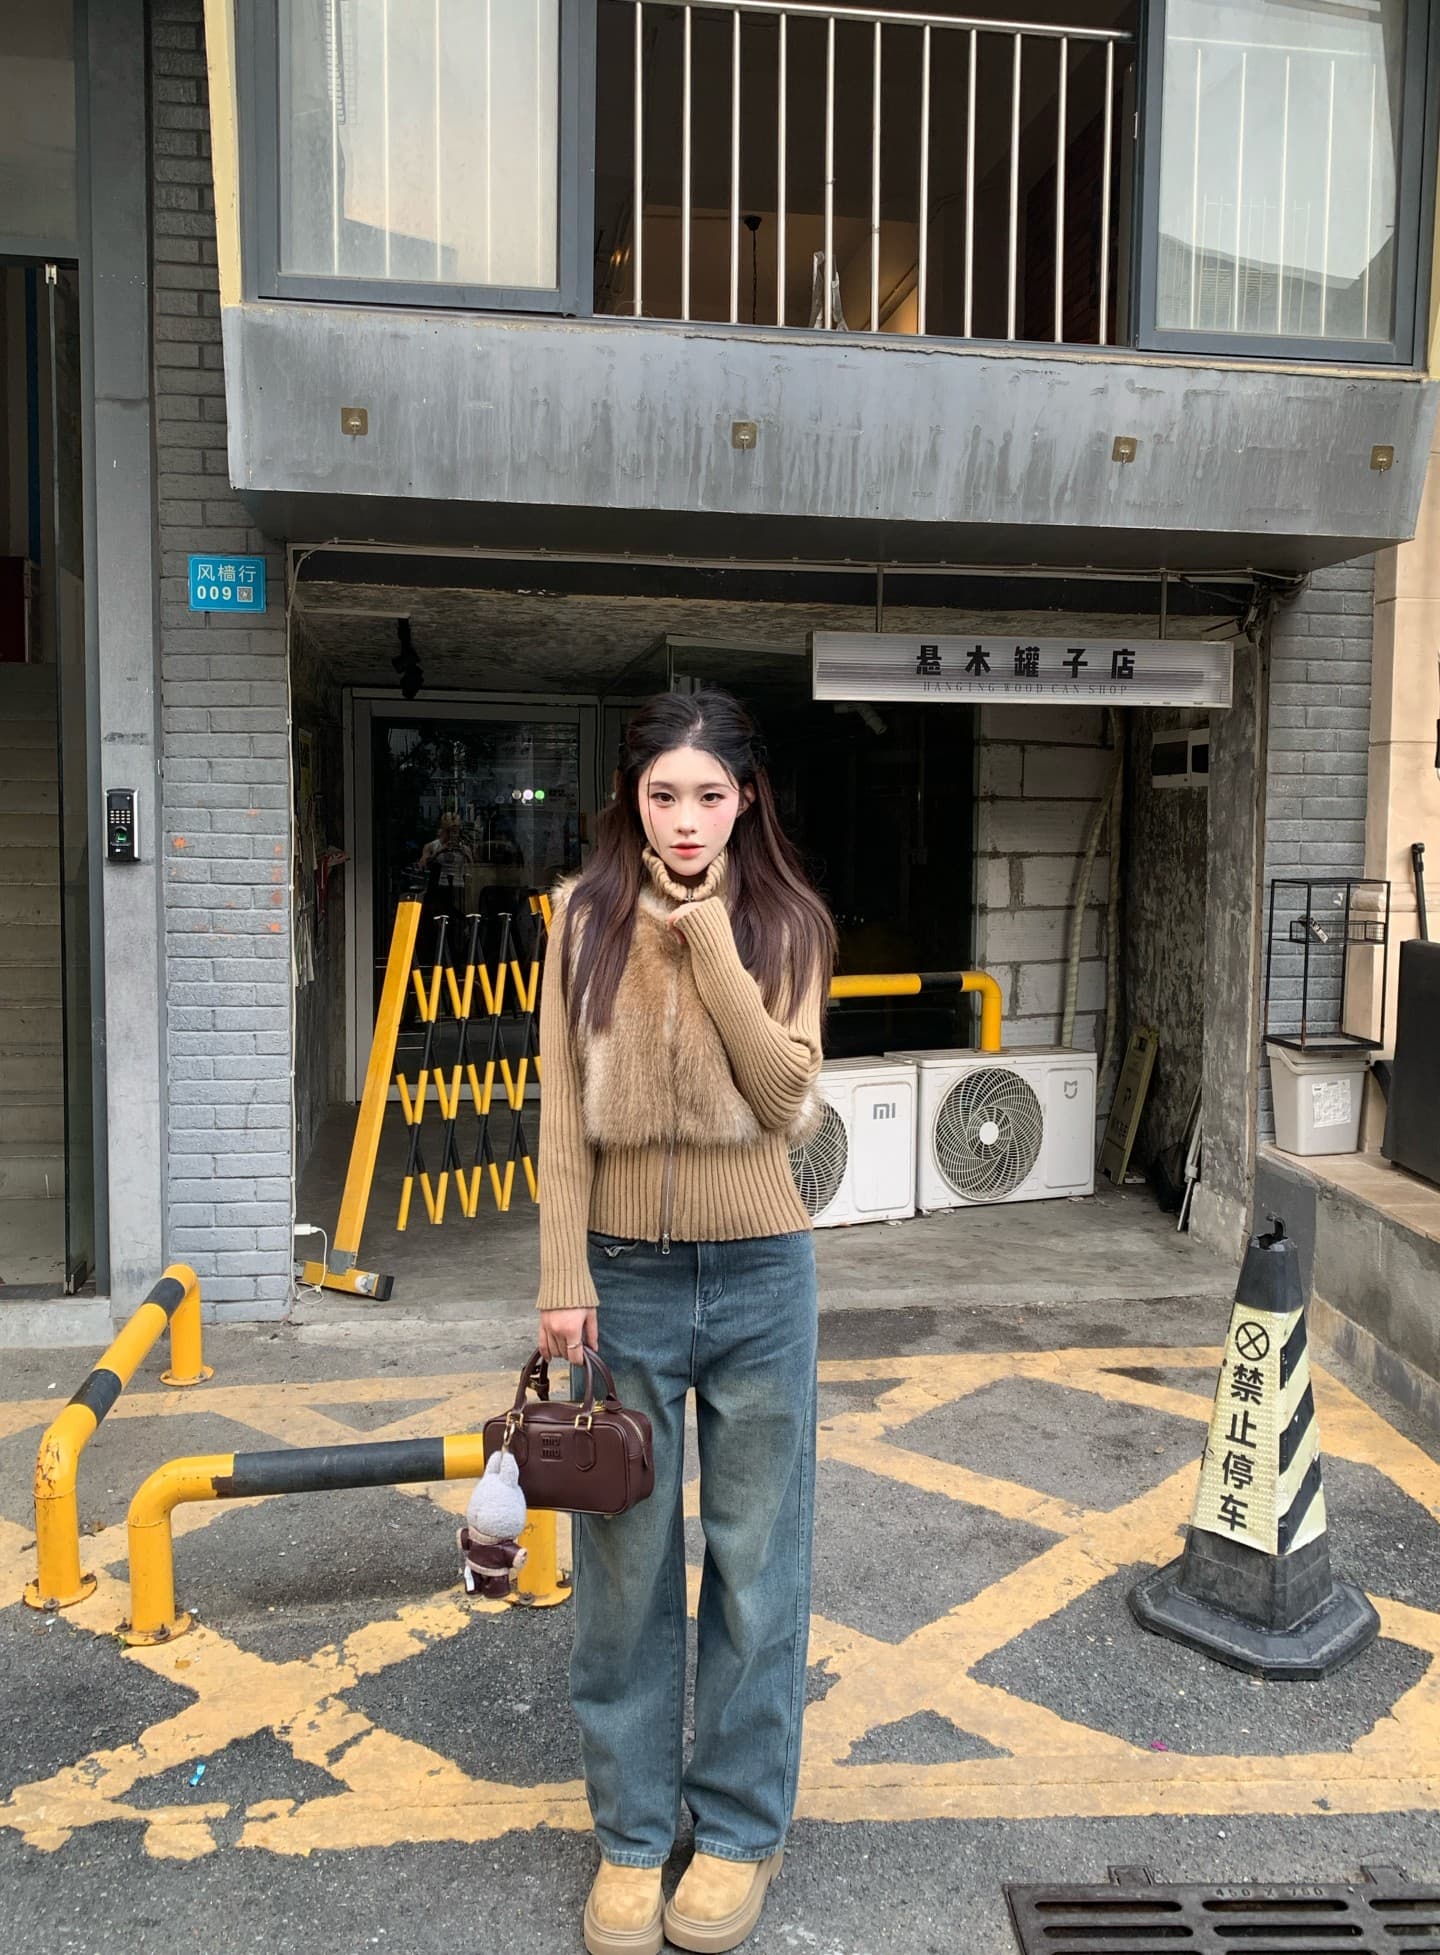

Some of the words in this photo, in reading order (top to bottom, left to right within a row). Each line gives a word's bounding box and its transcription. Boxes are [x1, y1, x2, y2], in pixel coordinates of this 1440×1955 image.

[197, 564, 257, 583] 风樯行
[197, 585, 232, 600] 009
[916, 644, 1136, 679] 悬木罐子店
[923, 681, 995, 693] HANGING
[1004, 682, 1043, 694] WOOD
[1051, 683, 1080, 694] CAN
[1088, 684, 1128, 696] SHOP
[1217, 1363, 1264, 1532] 禁止停车
